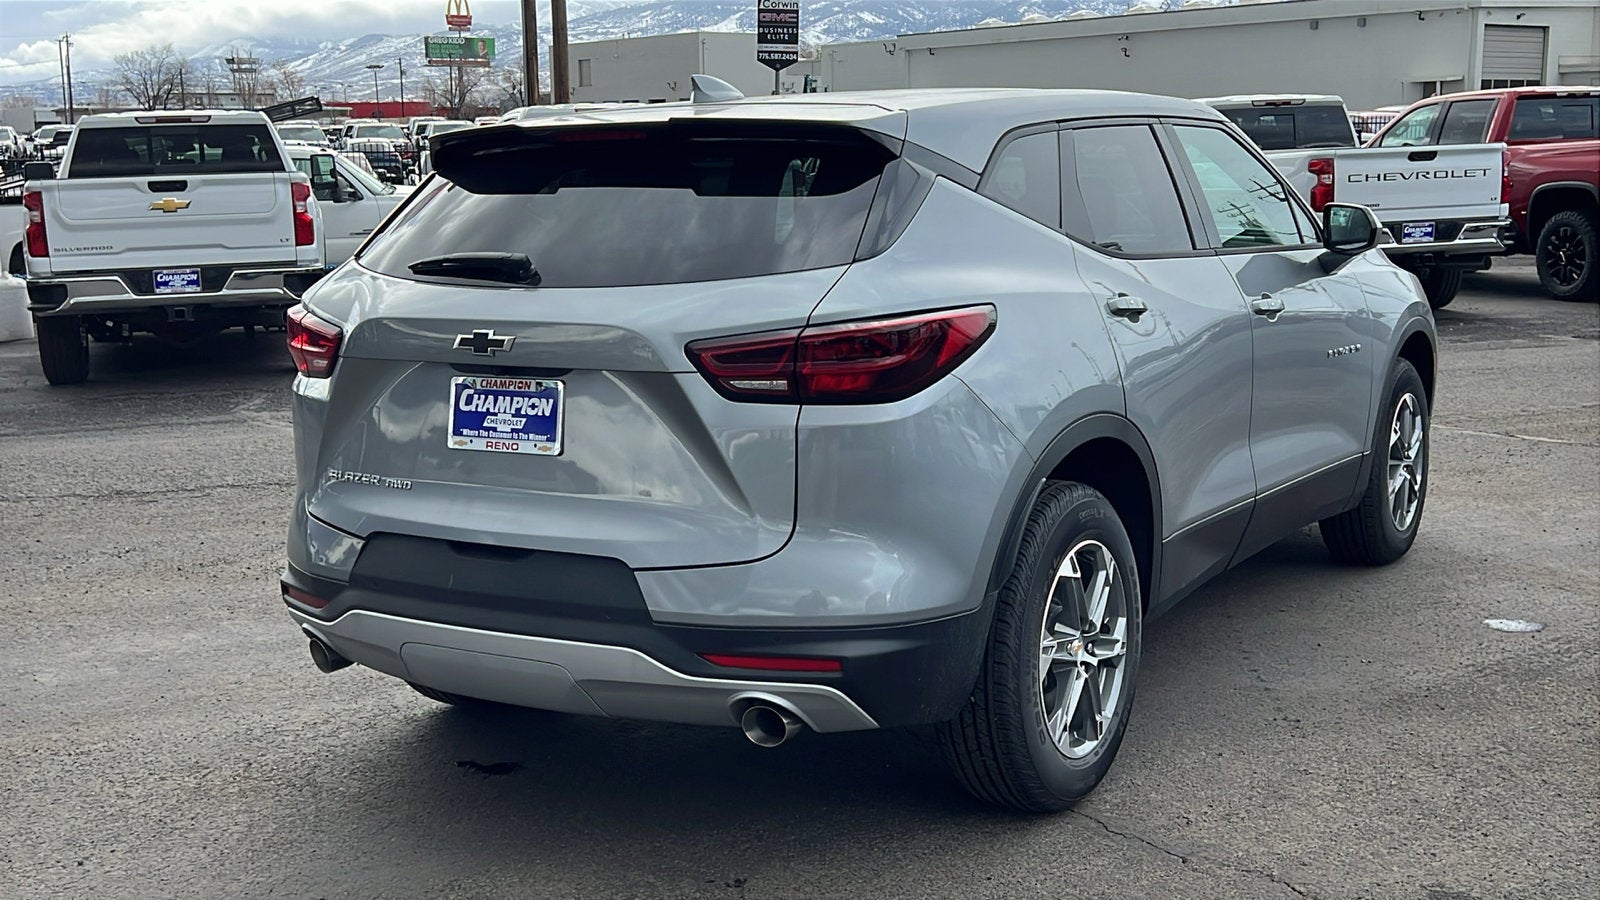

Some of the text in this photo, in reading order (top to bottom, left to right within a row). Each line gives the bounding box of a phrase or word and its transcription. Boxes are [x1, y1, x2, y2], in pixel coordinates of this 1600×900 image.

[762, 0, 799, 9] Corwin
[759, 12, 798, 22] GMC
[1347, 168, 1492, 183] CHEVROLET
[53, 245, 114, 253] SILVERADO
[157, 273, 198, 282] CHAMPION
[480, 379, 532, 390] CHAMPION
[459, 389, 554, 417] CHAMPION
[486, 417, 523, 427] CHEVROLET
[489, 430, 513, 439] Customer
[519, 432, 528, 440] The
[485, 441, 520, 451] RENO
[328, 469, 413, 490] BLAZER AWD
